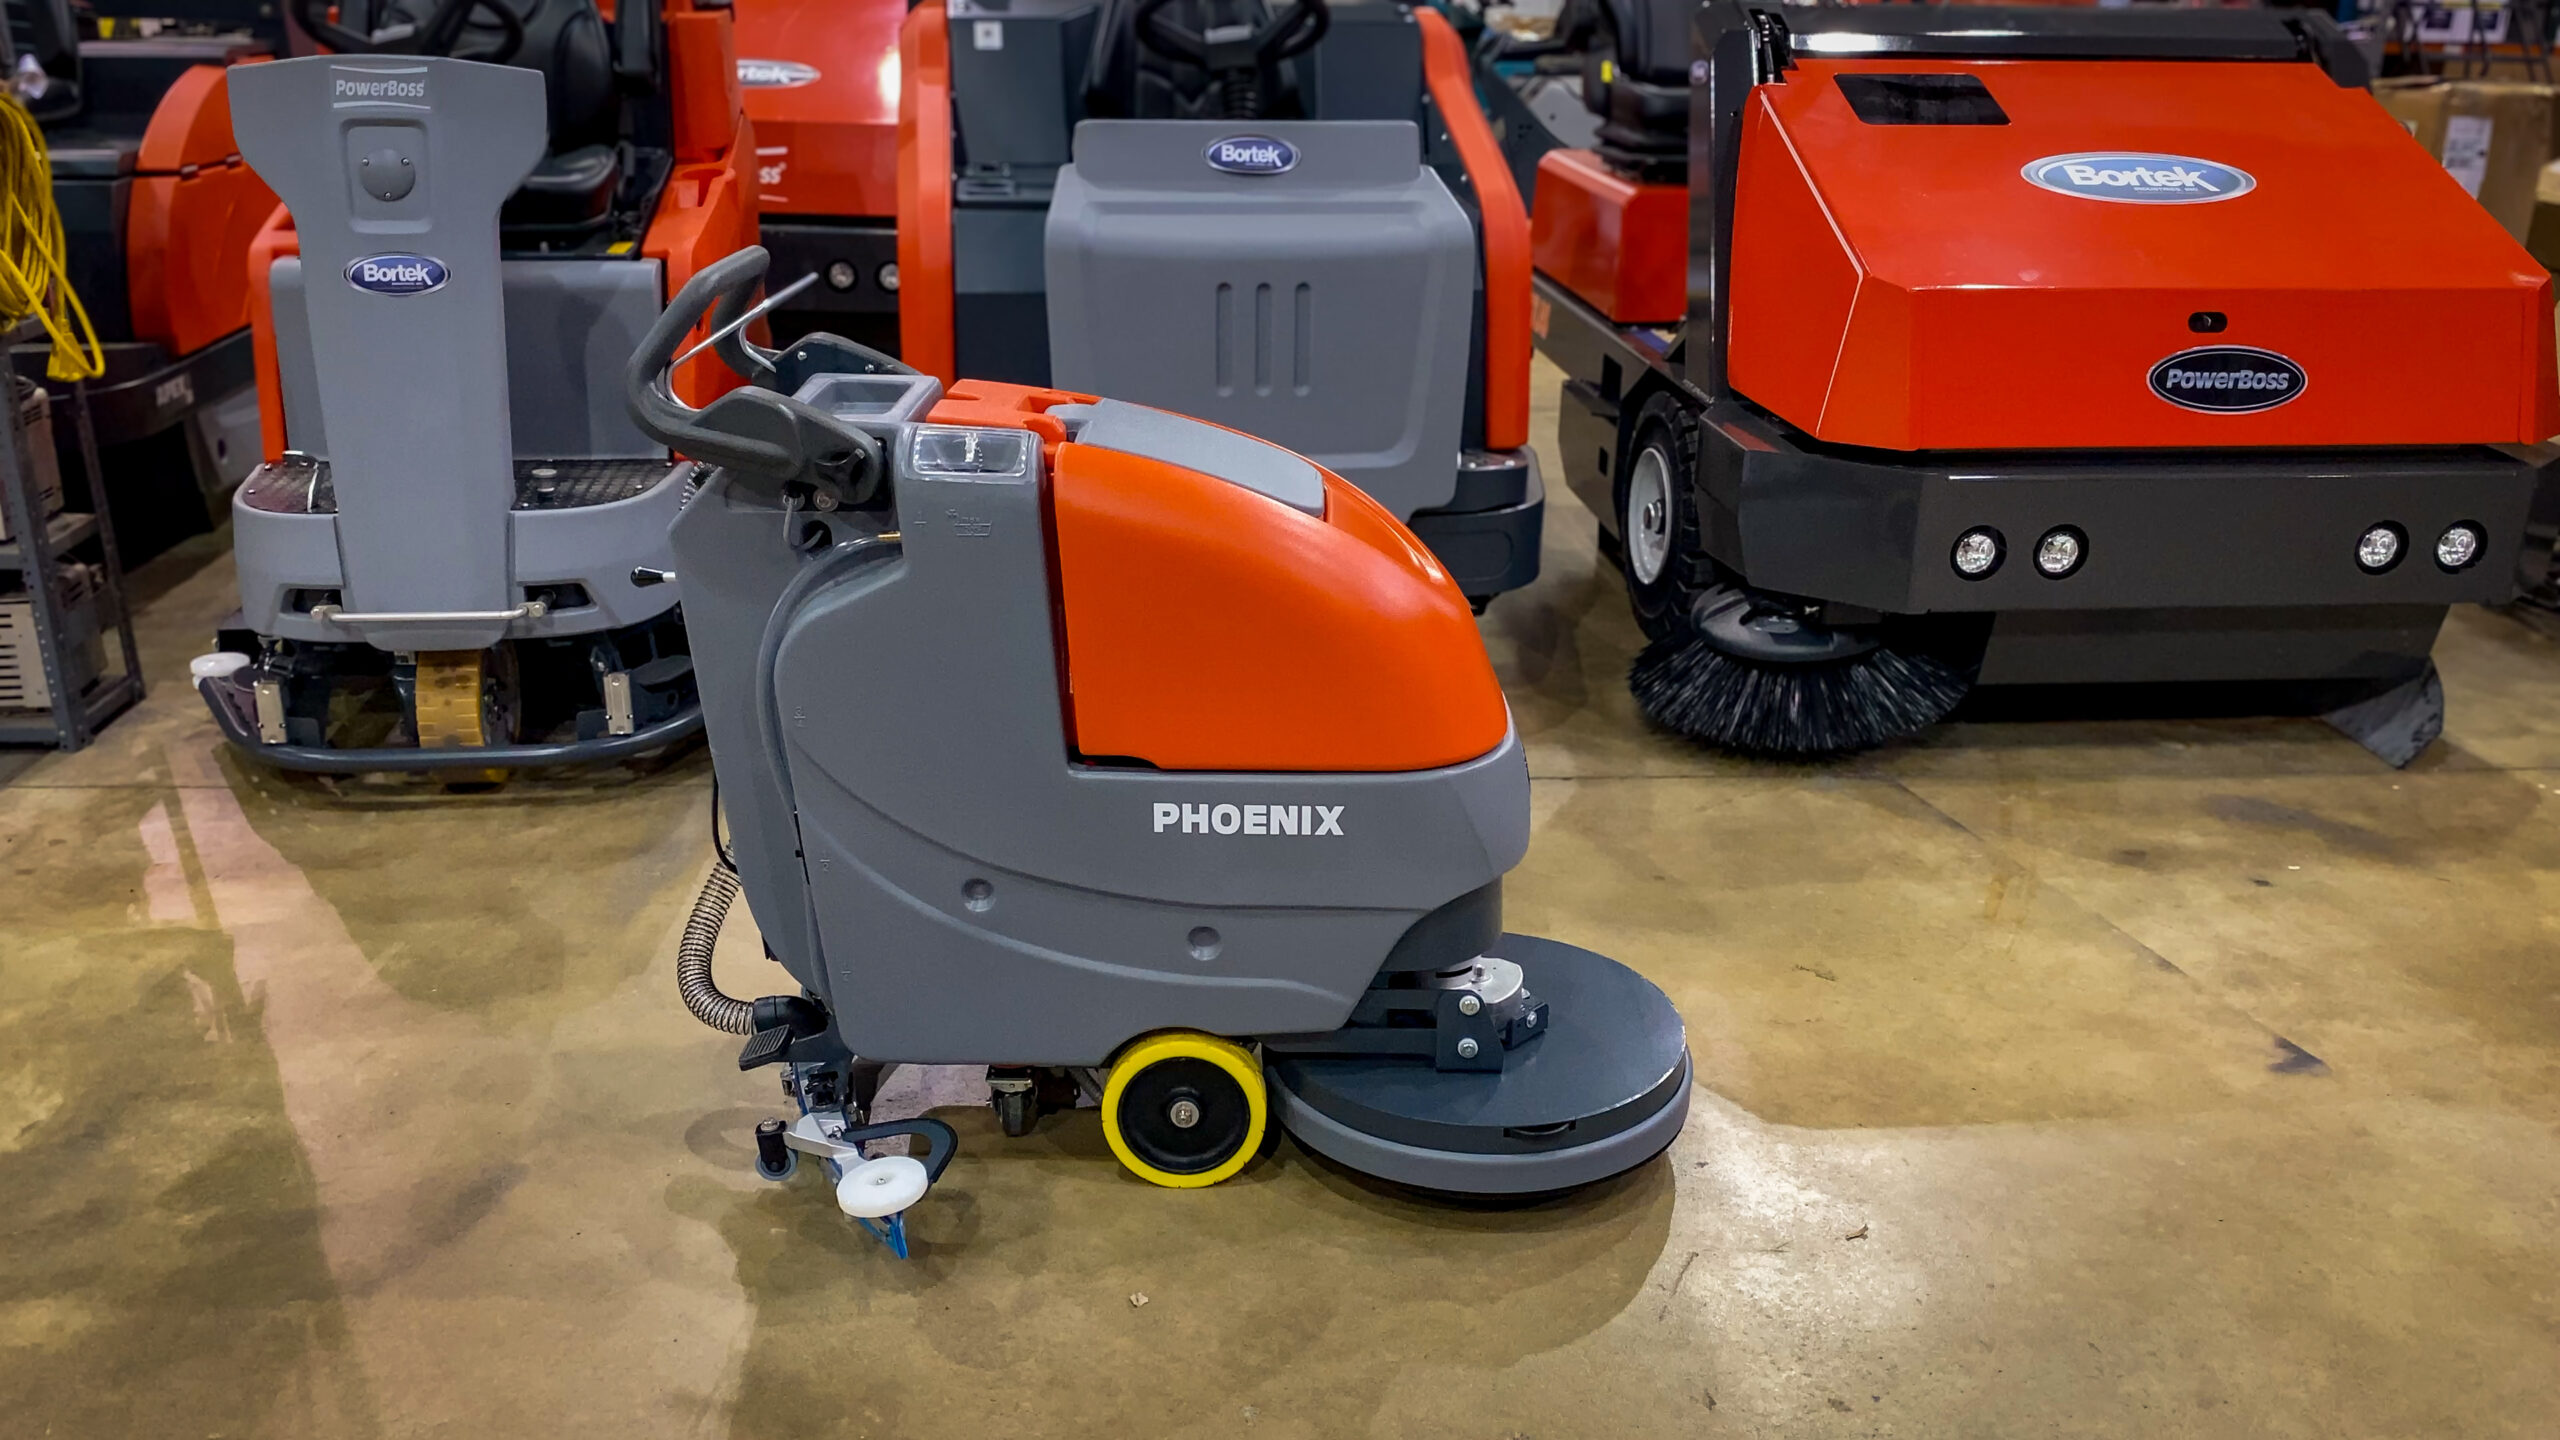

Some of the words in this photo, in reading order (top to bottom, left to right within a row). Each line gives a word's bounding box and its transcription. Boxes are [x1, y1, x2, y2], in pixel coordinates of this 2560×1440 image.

[336, 80, 424, 97] PowerBoss
[1221, 145, 1282, 167] Bortek
[2063, 165, 2220, 191] Bortek
[363, 263, 433, 286] Bortek
[2166, 369, 2289, 390] PowerBoss
[1153, 802, 1345, 836] PHOENIX
